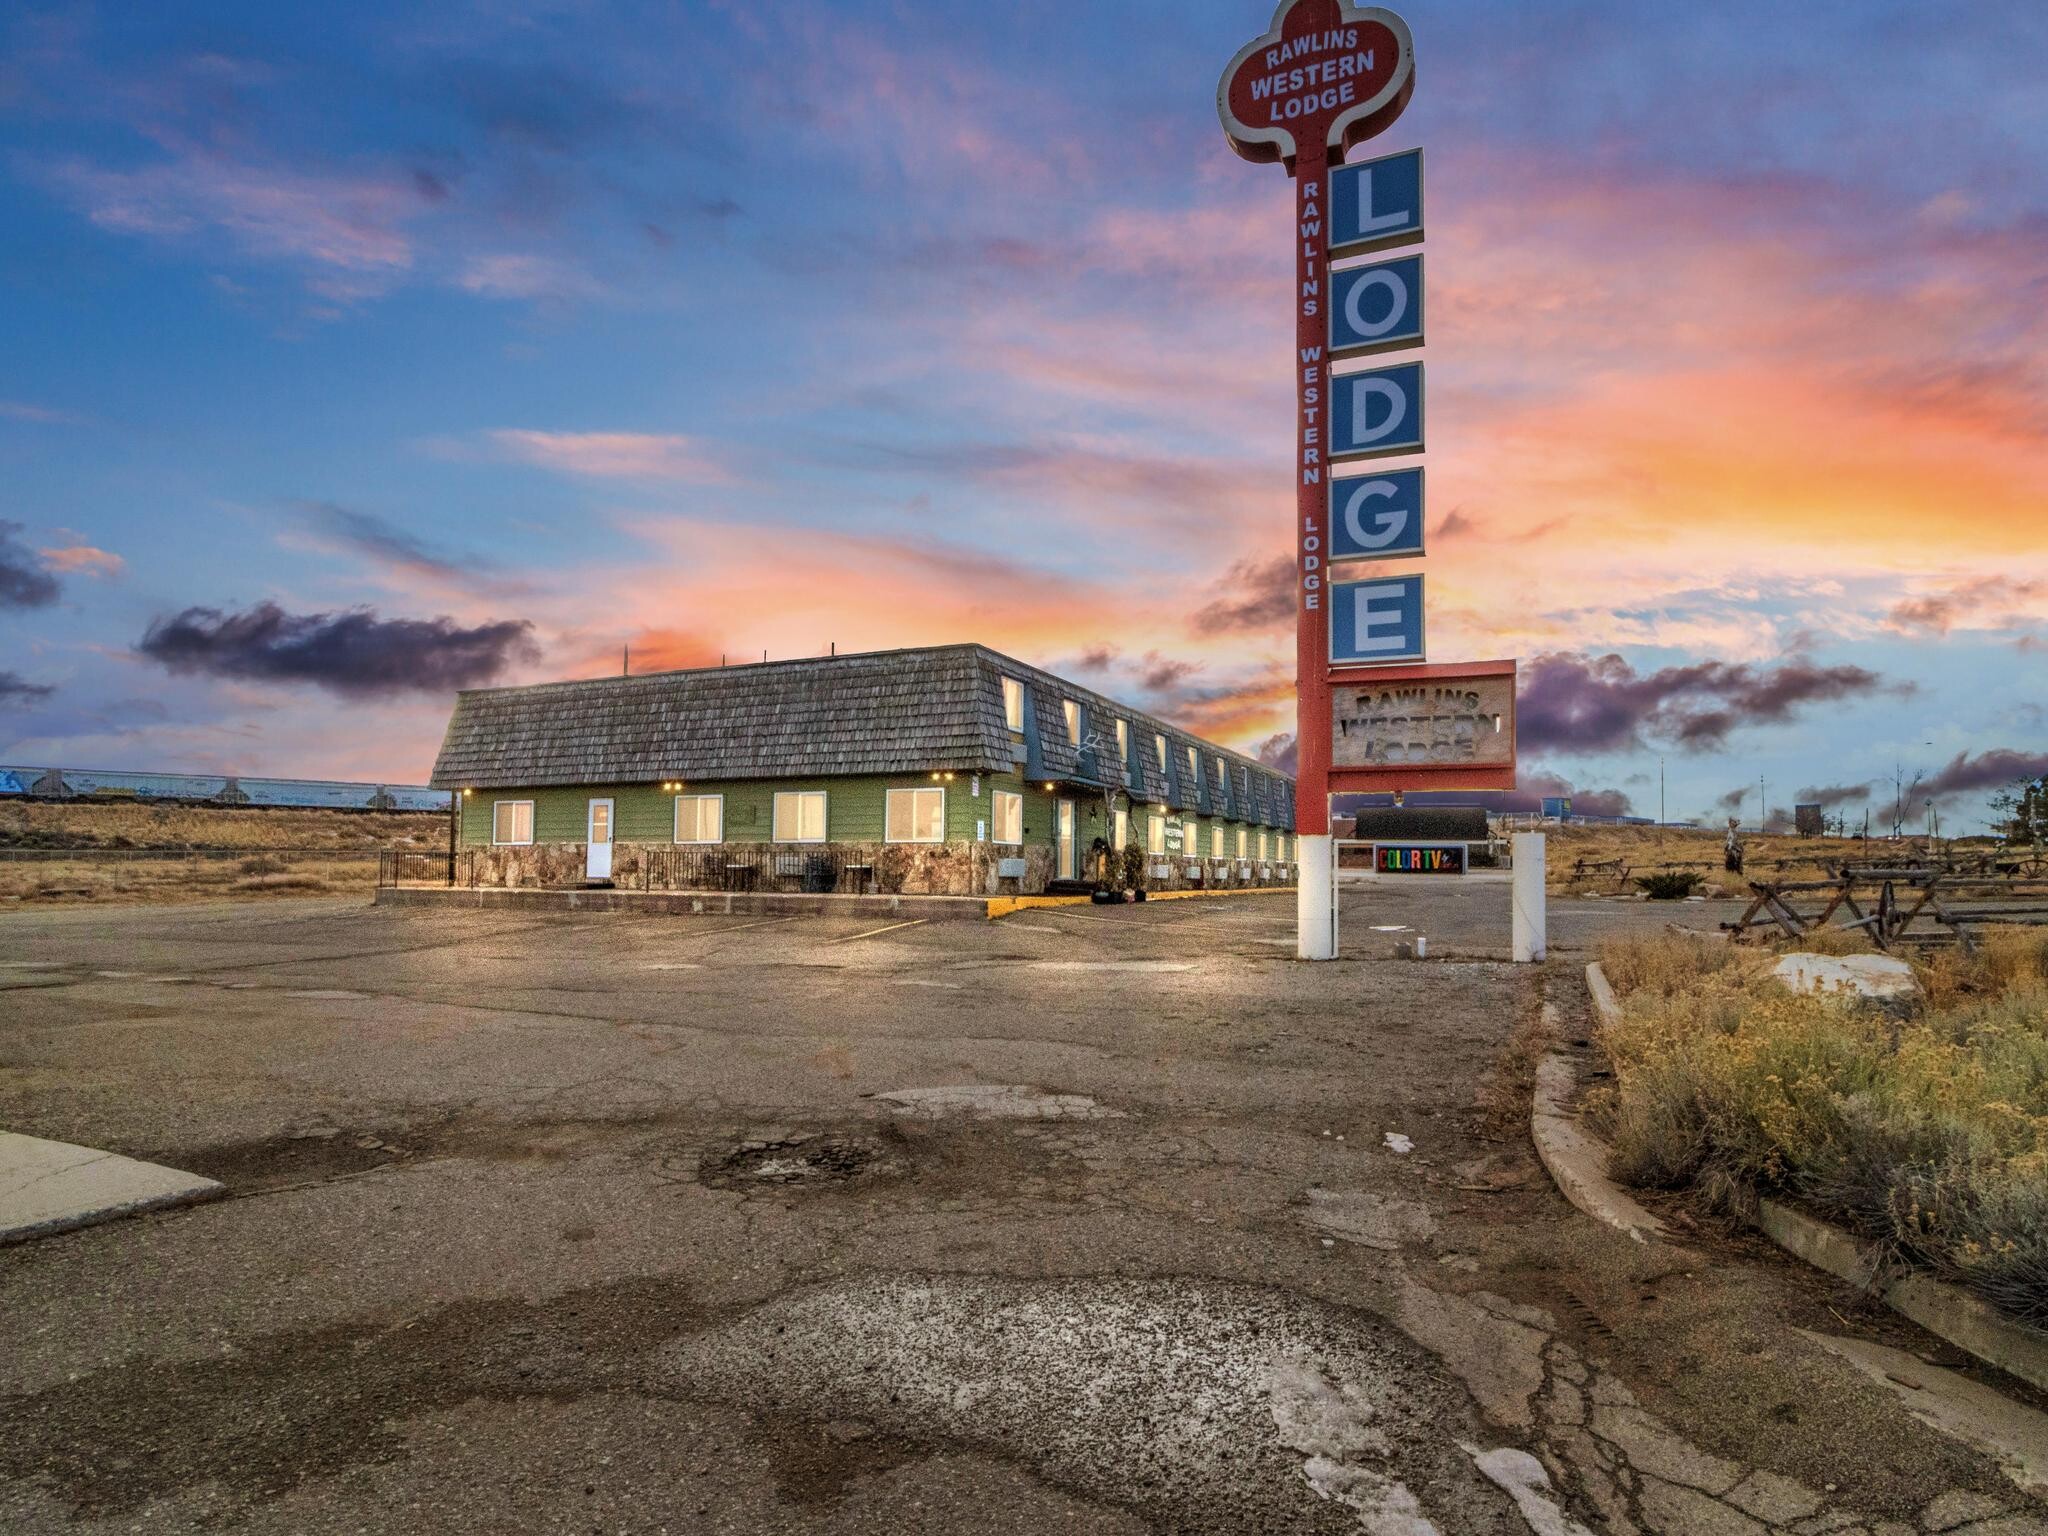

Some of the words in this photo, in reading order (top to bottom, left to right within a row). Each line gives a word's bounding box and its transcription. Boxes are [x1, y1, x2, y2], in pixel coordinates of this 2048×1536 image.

[1251, 49, 1375, 100] WESTERN
[1266, 29, 1358, 70] RAWLINS
[1270, 81, 1356, 121] LODGE
[1300, 182, 1321, 316] RAWLINS
[1300, 346, 1322, 485] WESTERN
[1345, 168, 1410, 652] LODGE
[1303, 516, 1320, 609] LODGE
[1378, 850, 1421, 869] COLOR
[1423, 850, 1441, 869] TV
